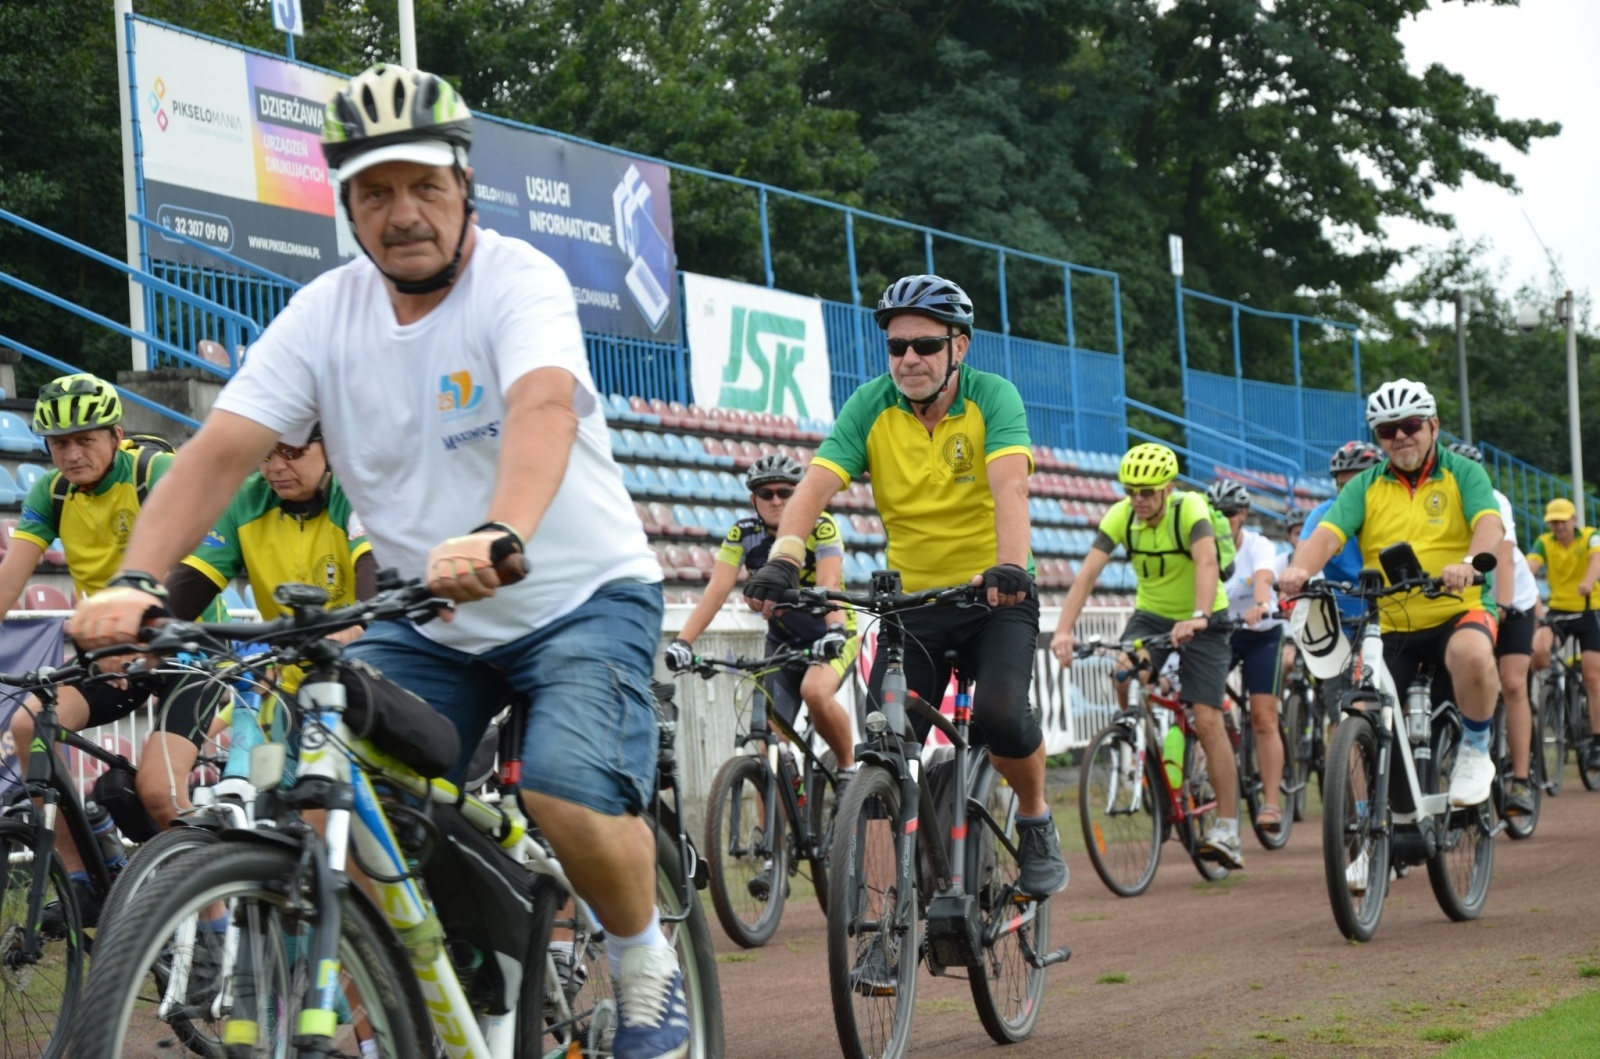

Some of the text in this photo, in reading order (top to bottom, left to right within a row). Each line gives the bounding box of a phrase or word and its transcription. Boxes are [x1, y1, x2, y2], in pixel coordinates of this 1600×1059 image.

[172, 99, 243, 132] PIKSELOMANIA
[259, 93, 325, 130] DZIERŻAWA
[263, 133, 309, 158] URZĄDZEŃ
[265, 155, 326, 184] DRUKUJĄCYCH
[474, 182, 519, 208] SELOMANIA
[525, 175, 572, 208] USŁUGI
[174, 216, 229, 243] 32 307 09 09
[528, 209, 614, 247] INFORMATYCZNE
[717, 305, 811, 418] JSK
